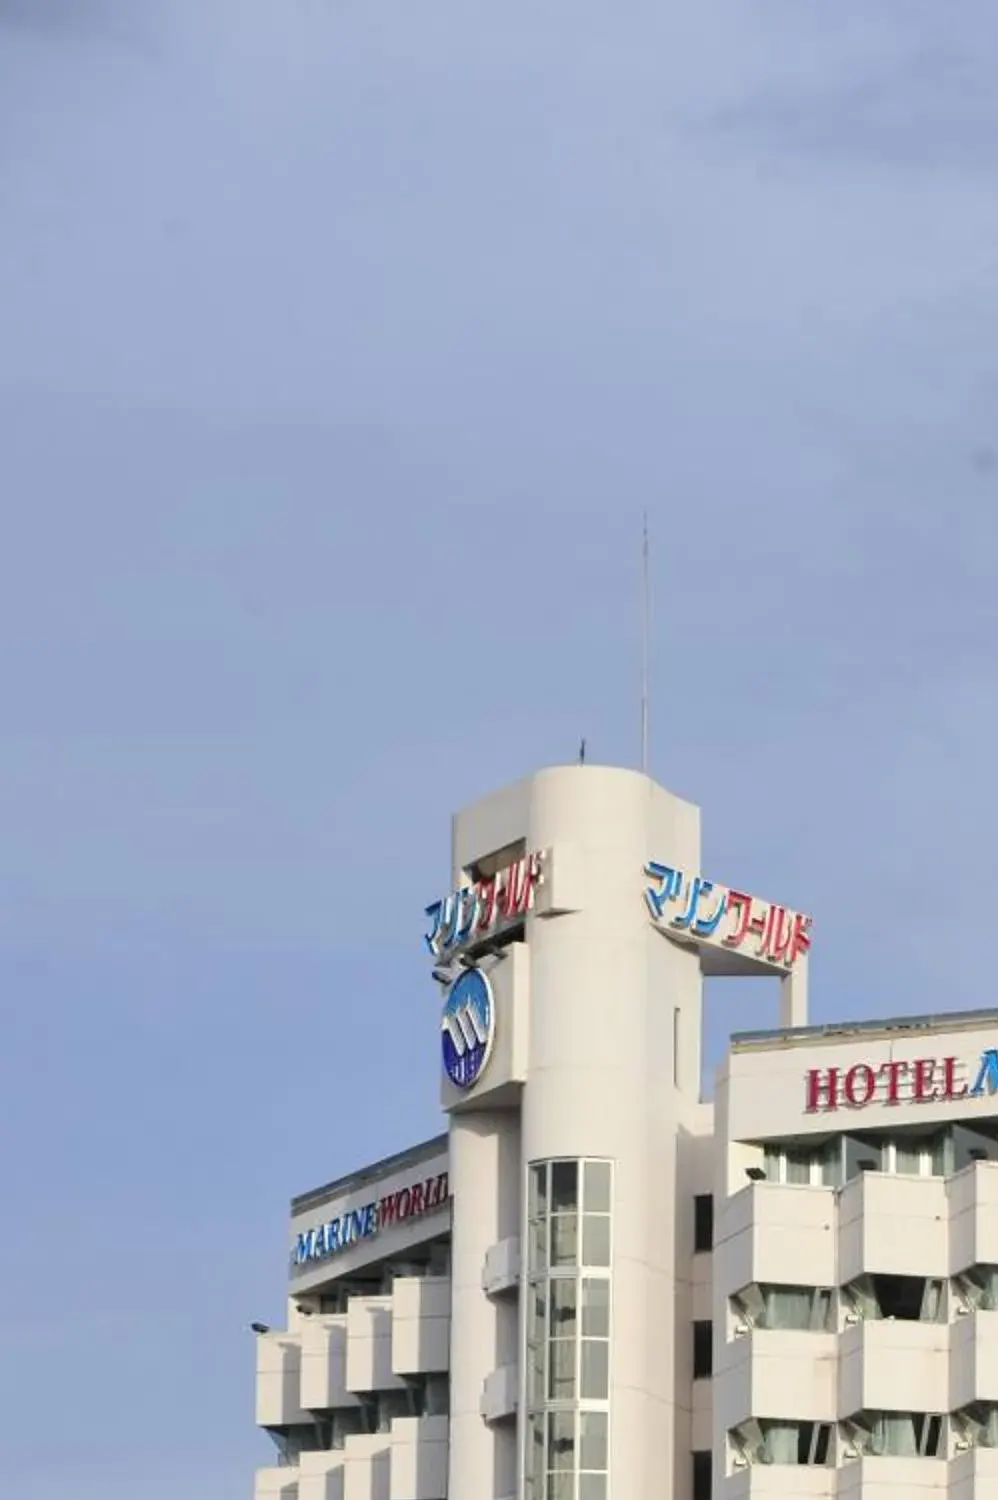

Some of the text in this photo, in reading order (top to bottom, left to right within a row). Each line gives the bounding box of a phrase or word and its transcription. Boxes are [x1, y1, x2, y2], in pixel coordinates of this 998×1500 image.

[643, 860, 813, 964] マリンワールド
[804, 1056, 974, 1114] HOTEL
[295, 1172, 449, 1264] MARINE WORLD
